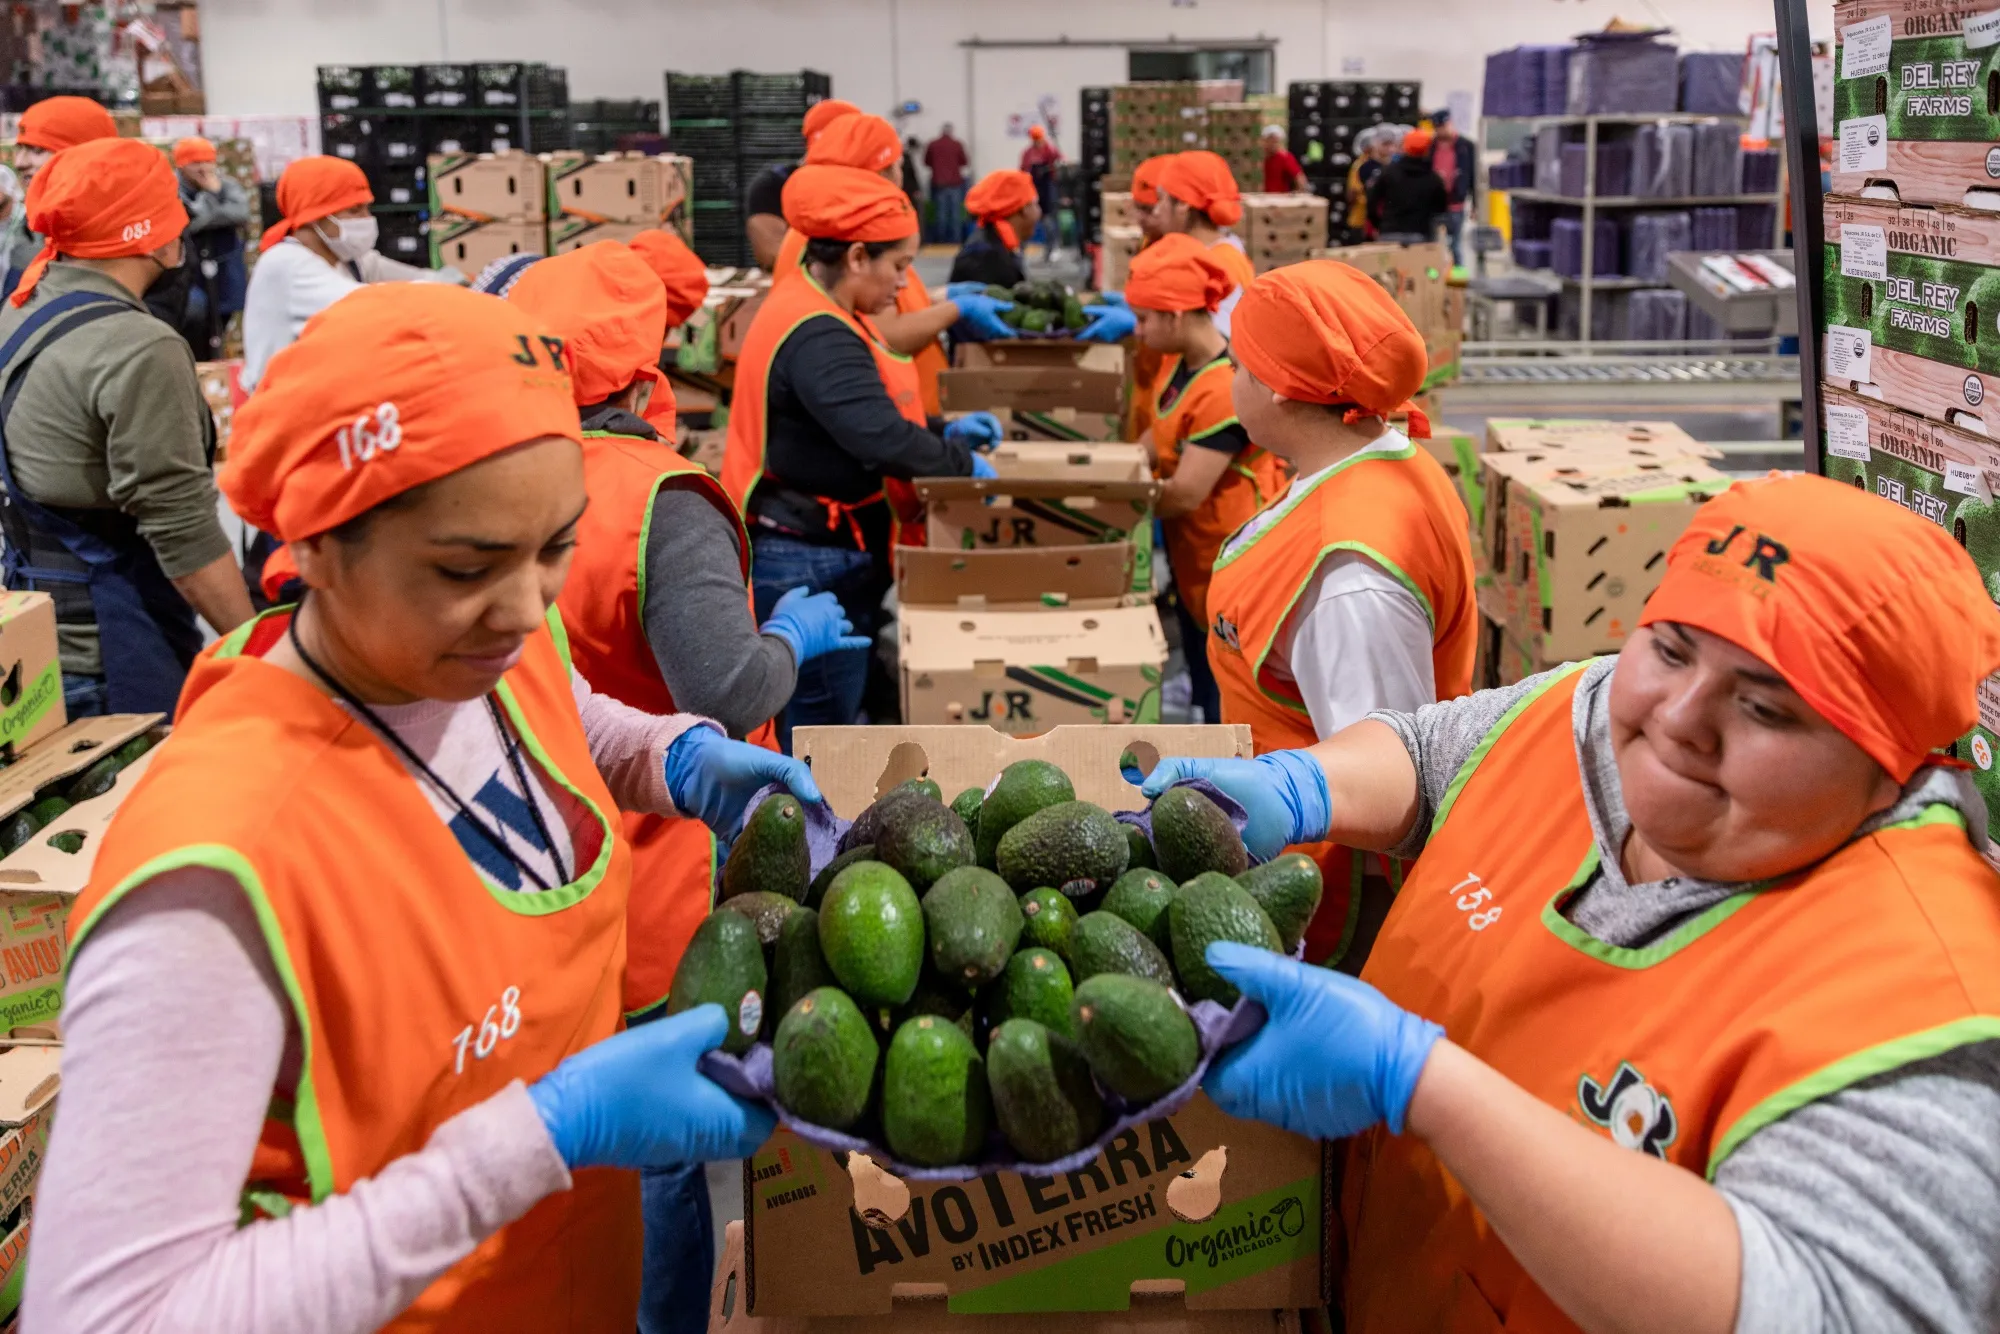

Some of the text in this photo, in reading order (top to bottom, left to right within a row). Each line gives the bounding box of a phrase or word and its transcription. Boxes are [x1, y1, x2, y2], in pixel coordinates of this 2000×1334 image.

[1901, 60, 1981, 89] DEL REY
[1907, 97, 1972, 117] FARMS
[122, 218, 151, 242] 083
[1835, 211, 1842, 219] 24
[1887, 216, 1896, 225] 32
[1916, 219, 1925, 229] 40
[1931, 220, 1940, 230] 48
[1888, 230, 1957, 257] ORGANIC
[1886, 277, 1960, 312] DEL REY
[1890, 309, 1950, 338] FARMS
[1968, 381, 1979, 390] USDA
[336, 401, 402, 471] 168
[1907, 428, 1915, 438] 40
[1880, 432, 1945, 472] ORGANIC
[1988, 455, 1999, 467] 70
[1878, 476, 1947, 525] DEL REY
[765, 1183, 817, 1210] AVOCADOS
[1165, 1211, 1274, 1268] Organic
[1221, 1234, 1282, 1262] AVOCADOS
[951, 1251, 976, 1272] BY
